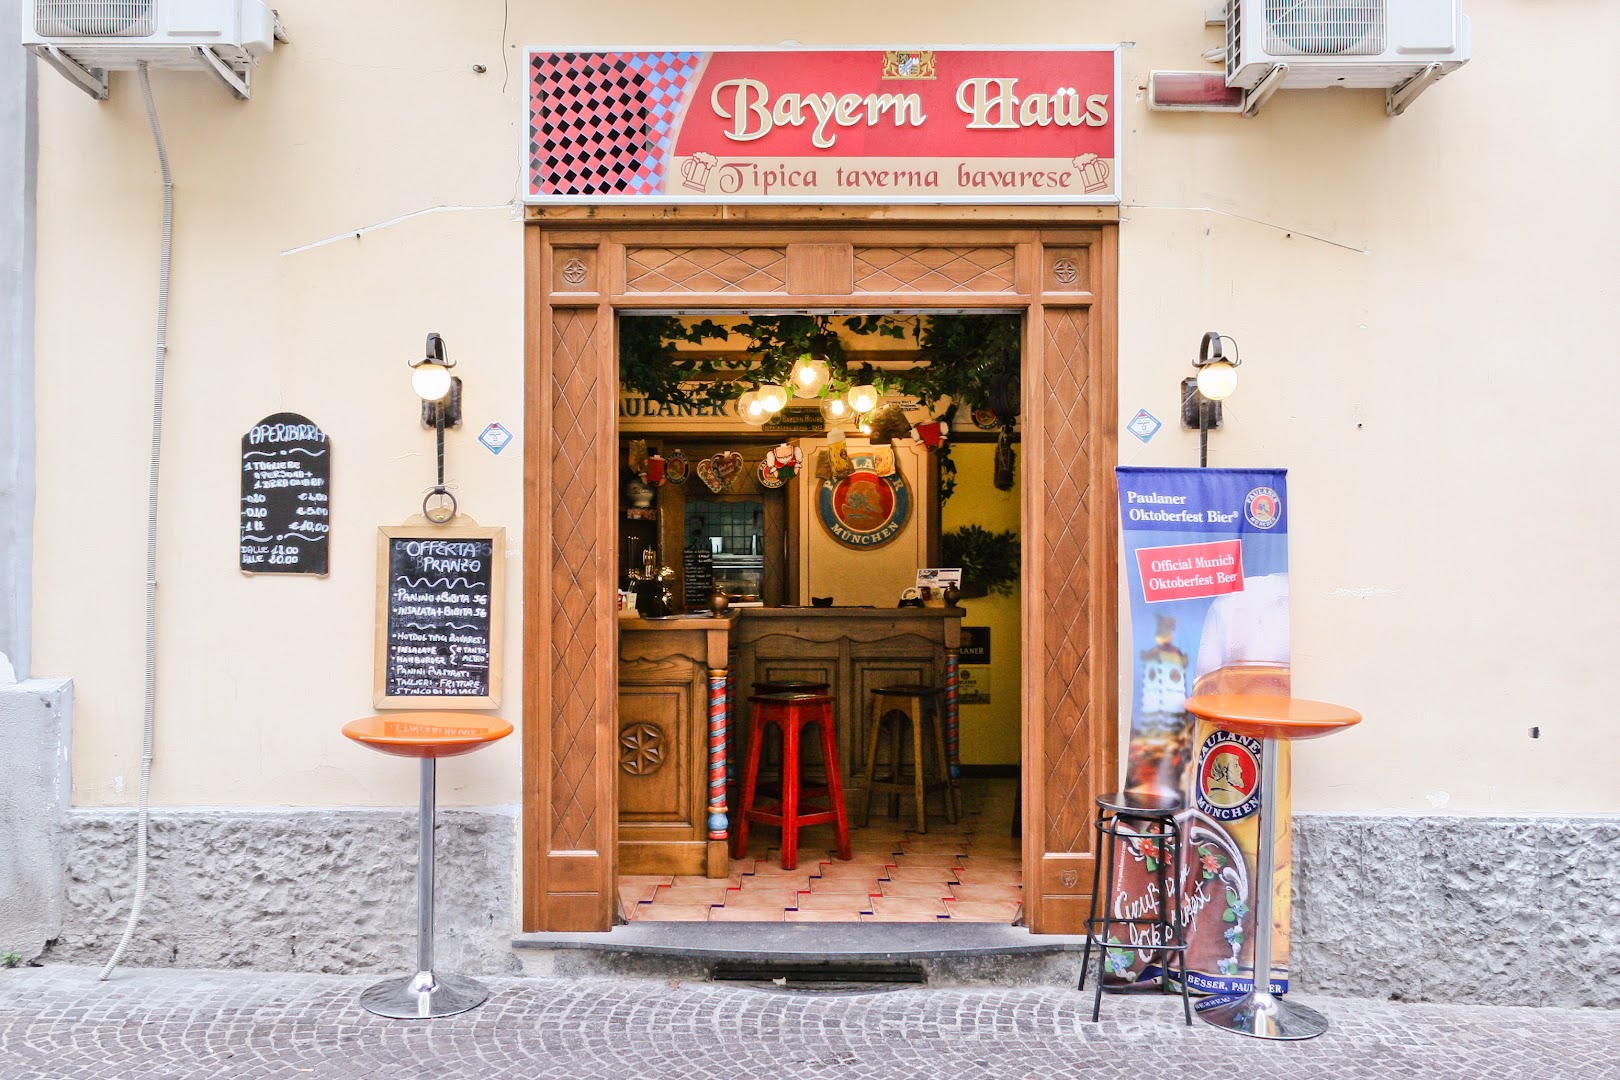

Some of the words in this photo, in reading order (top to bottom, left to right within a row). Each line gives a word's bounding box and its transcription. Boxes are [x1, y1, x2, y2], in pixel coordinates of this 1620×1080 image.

[710, 77, 927, 149] Bayern
[955, 77, 1110, 131] Haüs
[717, 162, 819, 196] Tipica
[836, 163, 940, 188] taverna
[956, 162, 1073, 188] bavarese
[249, 423, 325, 445] APERIBIRRA
[244, 462, 253, 471] 1
[1127, 491, 1186, 505] Paulaner
[1129, 508, 1204, 523] Oktoberfest
[240, 546, 269, 554] DALLE
[406, 541, 476, 557] OFFERTA
[424, 556, 481, 573] PRANZO
[1151, 558, 1192, 573] Official
[1195, 554, 1235, 568] Munich
[1149, 574, 1214, 590] Oktoberfest
[1216, 571, 1238, 584] Beer
[449, 633, 486, 644] BAVARESI
[397, 646, 437, 655] INSALATE
[396, 656, 447, 665] HAMBURGER
[396, 665, 425, 675] PANINI
[396, 678, 432, 686] TAGLIERI
[439, 679, 480, 689] FRITTURE
[1197, 796, 1259, 819] MÜNCHEN
[1187, 975, 1228, 991] BESSER,
